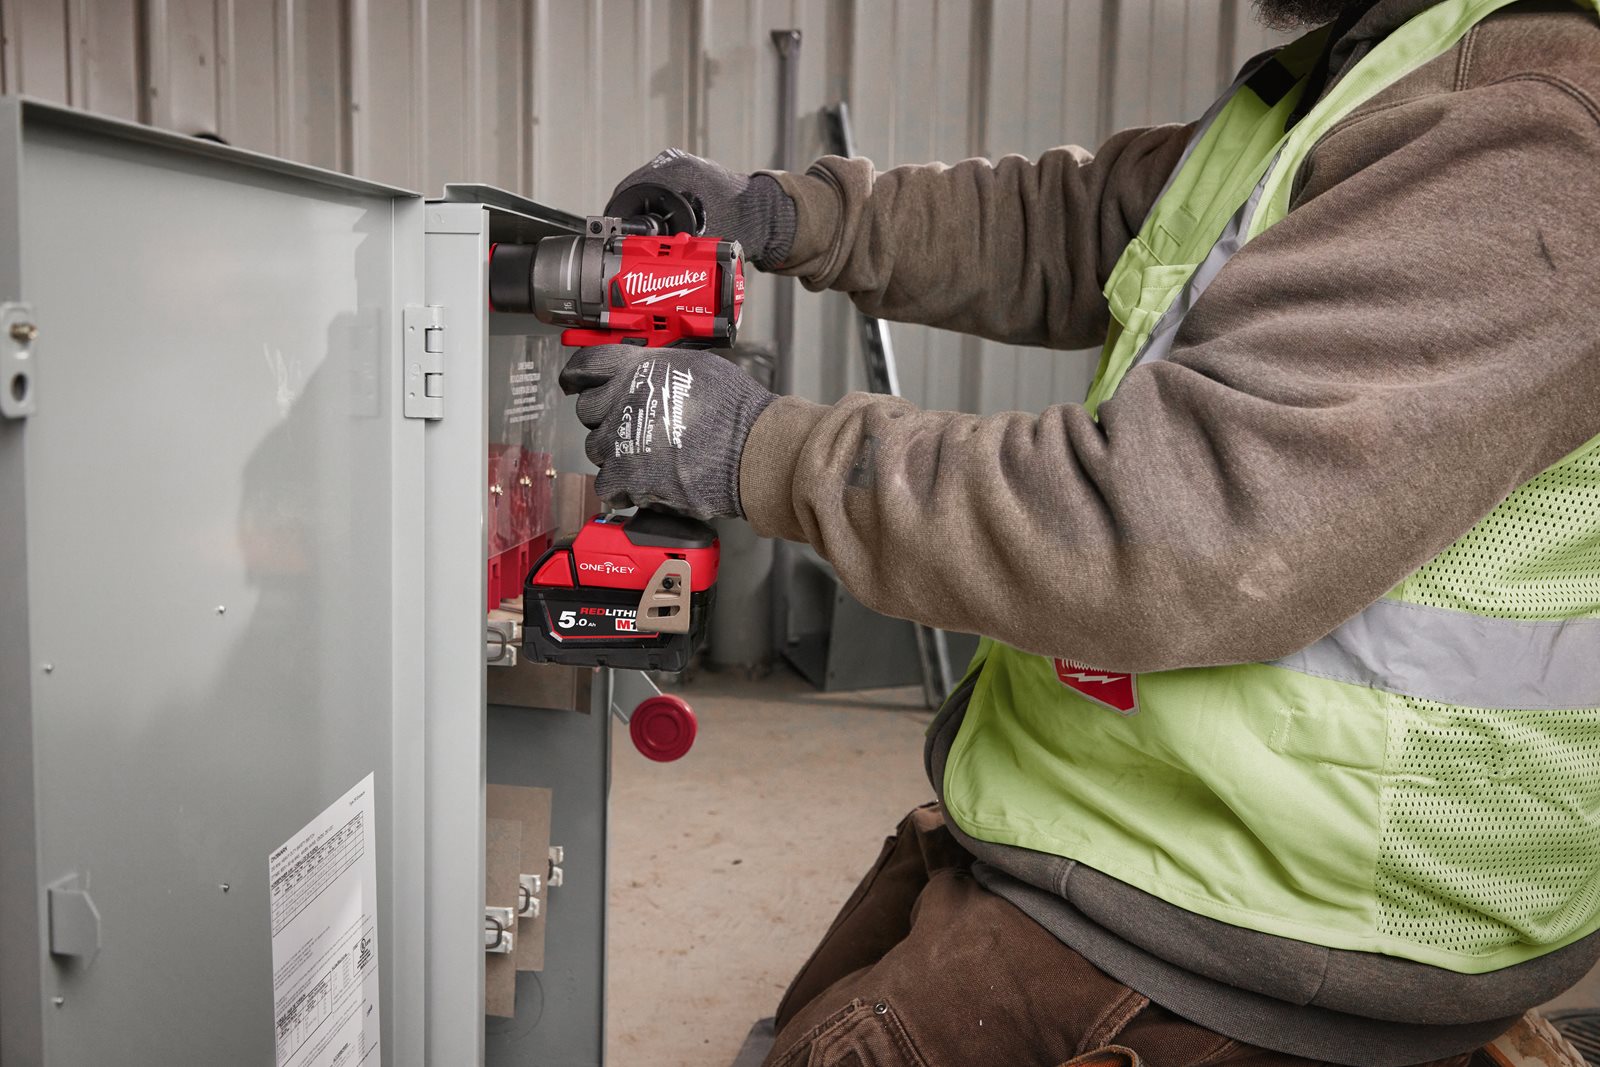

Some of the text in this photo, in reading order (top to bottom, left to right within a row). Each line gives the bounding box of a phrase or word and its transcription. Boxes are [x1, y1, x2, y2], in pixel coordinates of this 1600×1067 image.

[622, 269, 707, 295] Milwaukee
[675, 305, 713, 314] FUEL
[671, 368, 694, 448] Milwaukee
[645, 419, 654, 445] LEVEL
[579, 562, 605, 571] ONE
[580, 607, 637, 618] REDLITHI
[616, 620, 637, 630] M1
